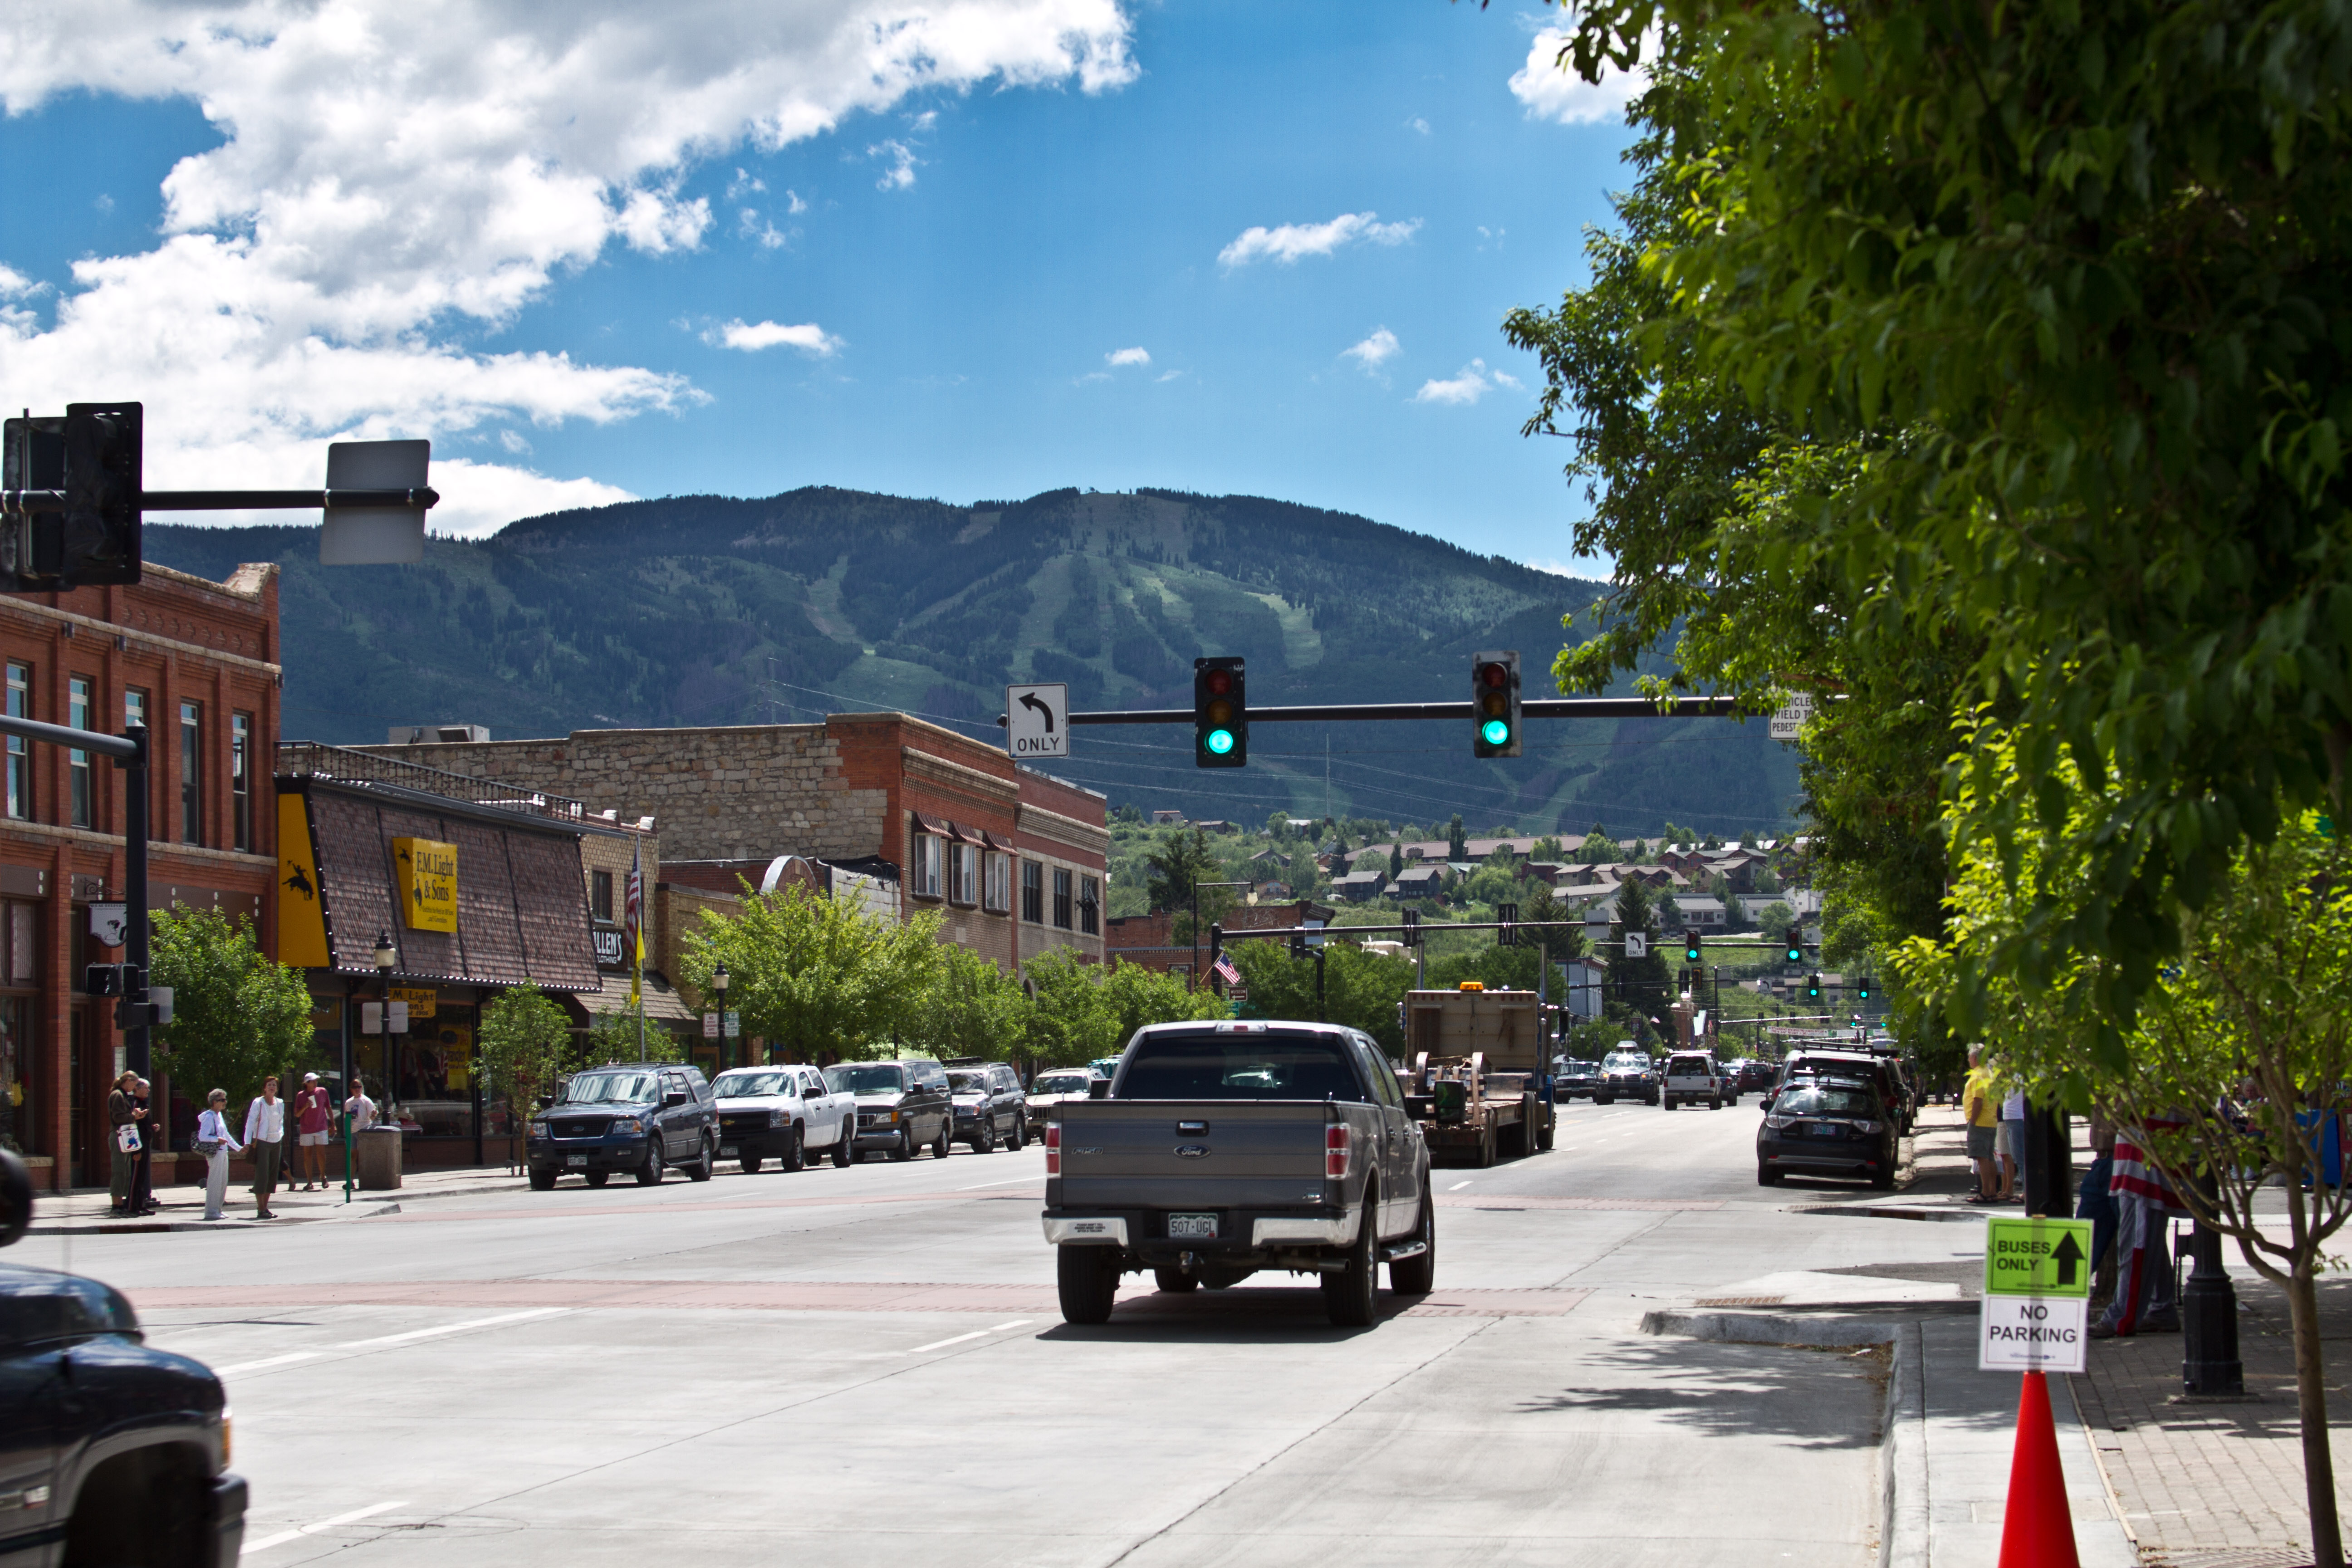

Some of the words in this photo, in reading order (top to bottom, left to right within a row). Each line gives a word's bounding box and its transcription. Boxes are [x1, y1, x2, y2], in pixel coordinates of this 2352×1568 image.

[1775, 710, 1800, 719] YIELD
[1018, 737, 1060, 751] ONLY
[434, 854, 454, 882] Light
[424, 880, 430, 899] &
[432, 879, 449, 901] Sons
[597, 955, 617, 964] LOTHING
[409, 990, 434, 1003] Light
[1182, 1146, 1202, 1155] Ford
[1998, 1240, 2051, 1254] BUSES
[1997, 1258, 2038, 1271] ONLY
[2020, 1305, 2048, 1320] NO
[1990, 1326, 2077, 1343] PARKING
